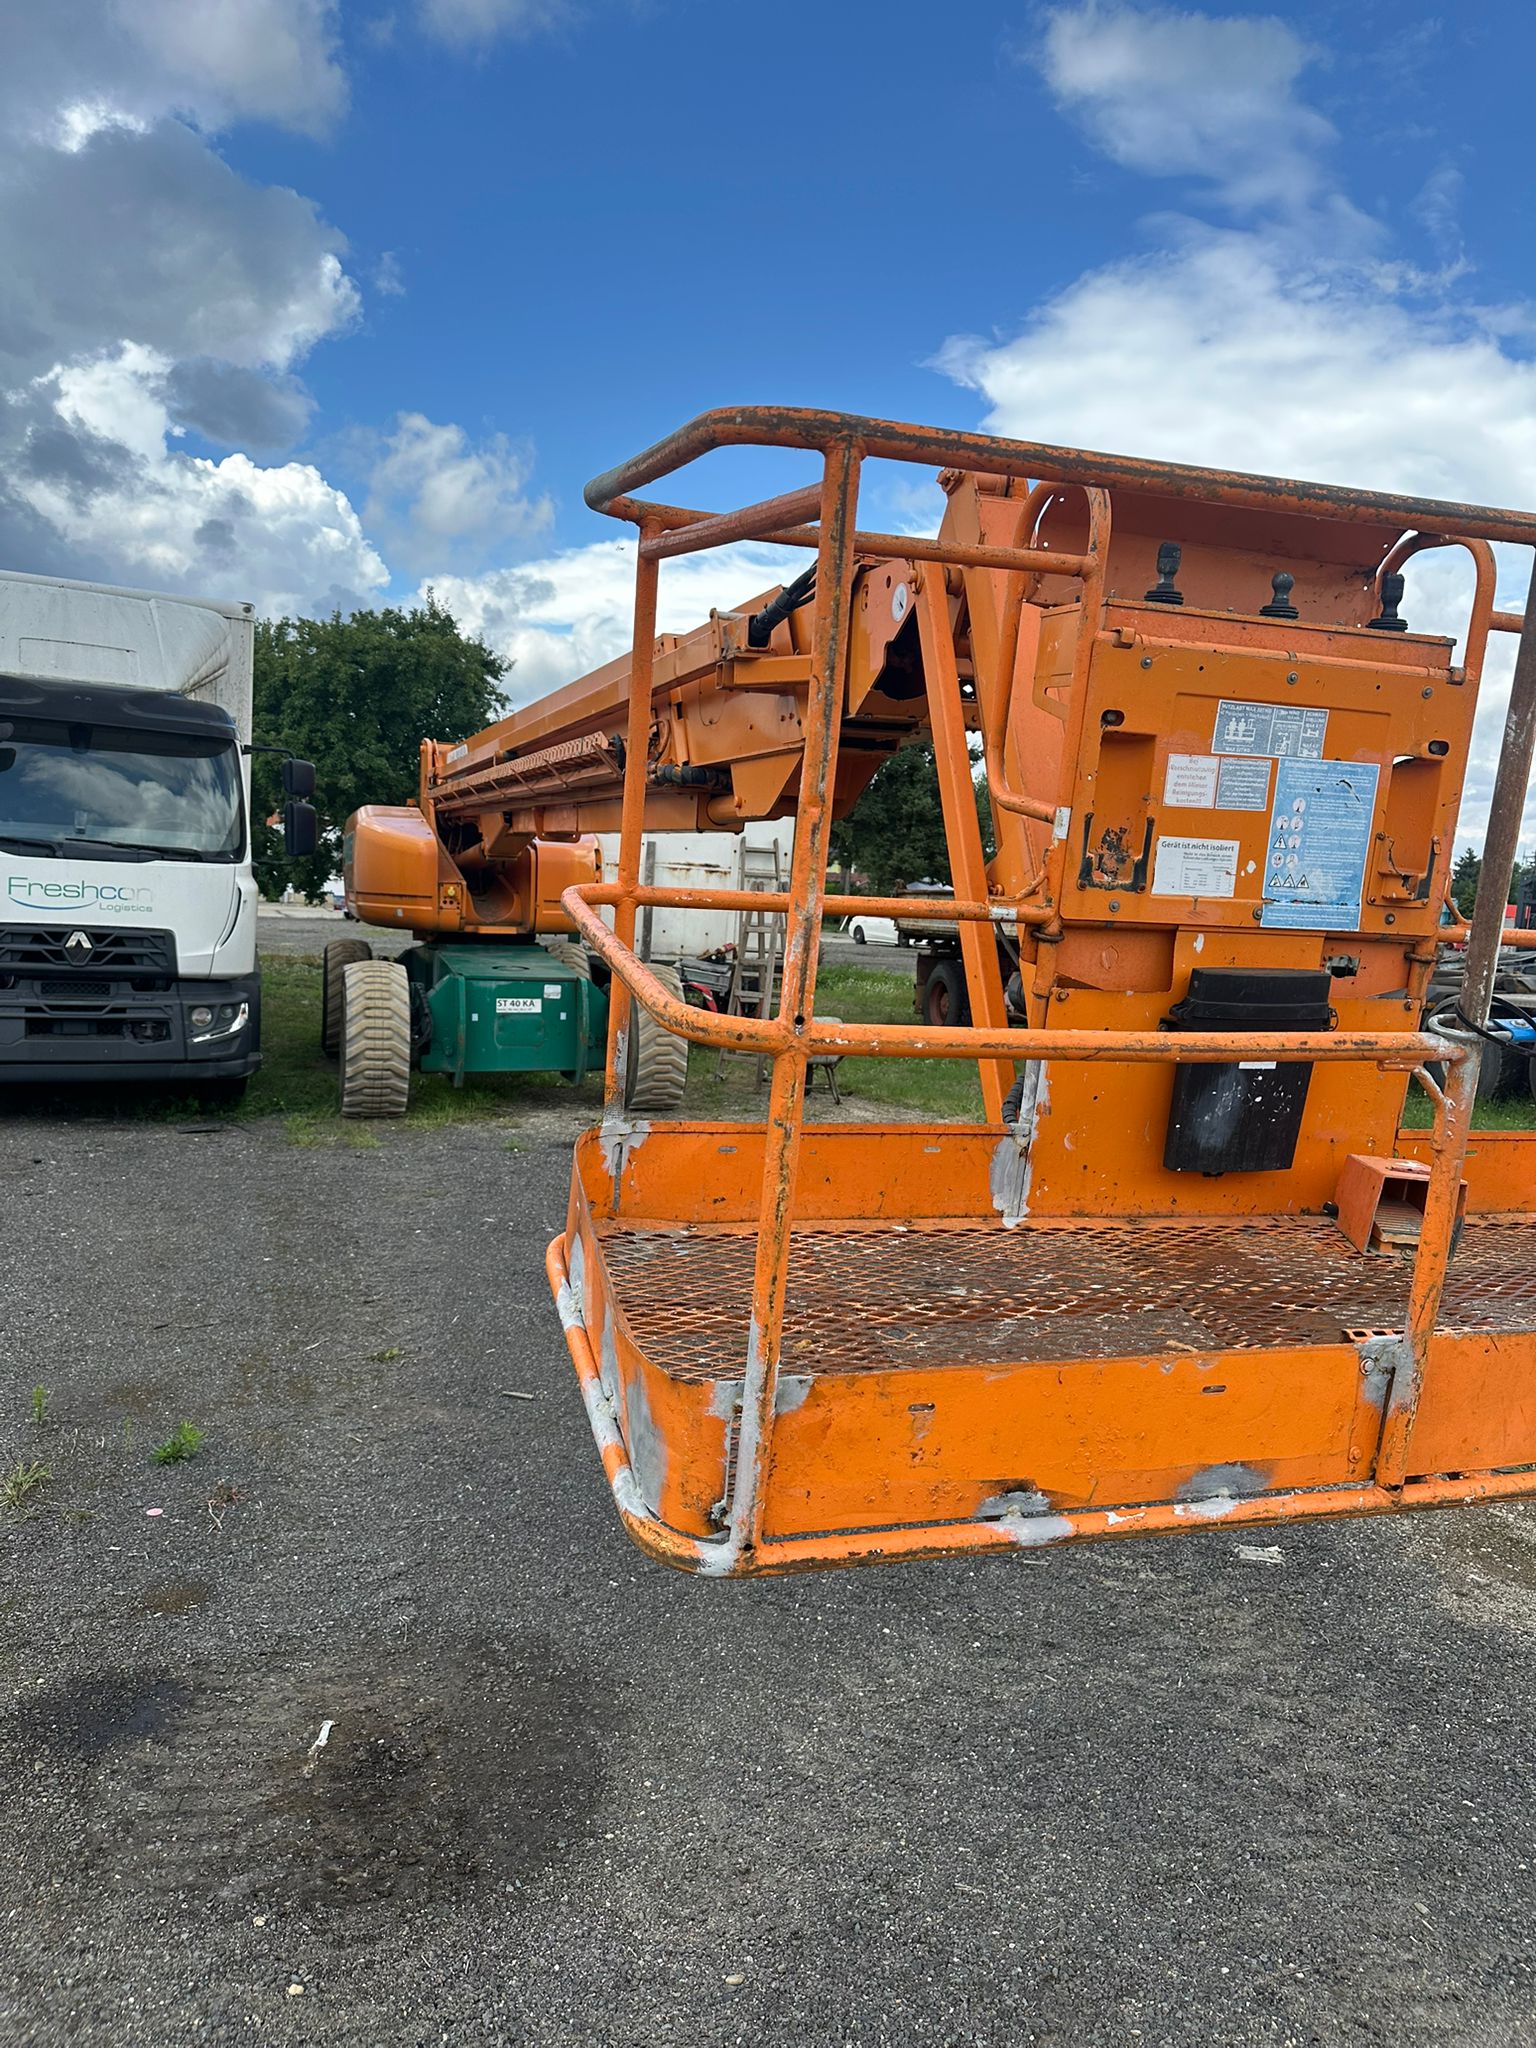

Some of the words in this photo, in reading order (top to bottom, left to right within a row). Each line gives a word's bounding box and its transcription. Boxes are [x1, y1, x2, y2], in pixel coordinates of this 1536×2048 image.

[1161, 841, 1181, 849] Gerät
[1191, 842, 1209, 850] nicht
[1210, 844, 1235, 852] isoliert
[8, 876, 153, 902] Freshcon
[99, 902, 153, 913] Logistics
